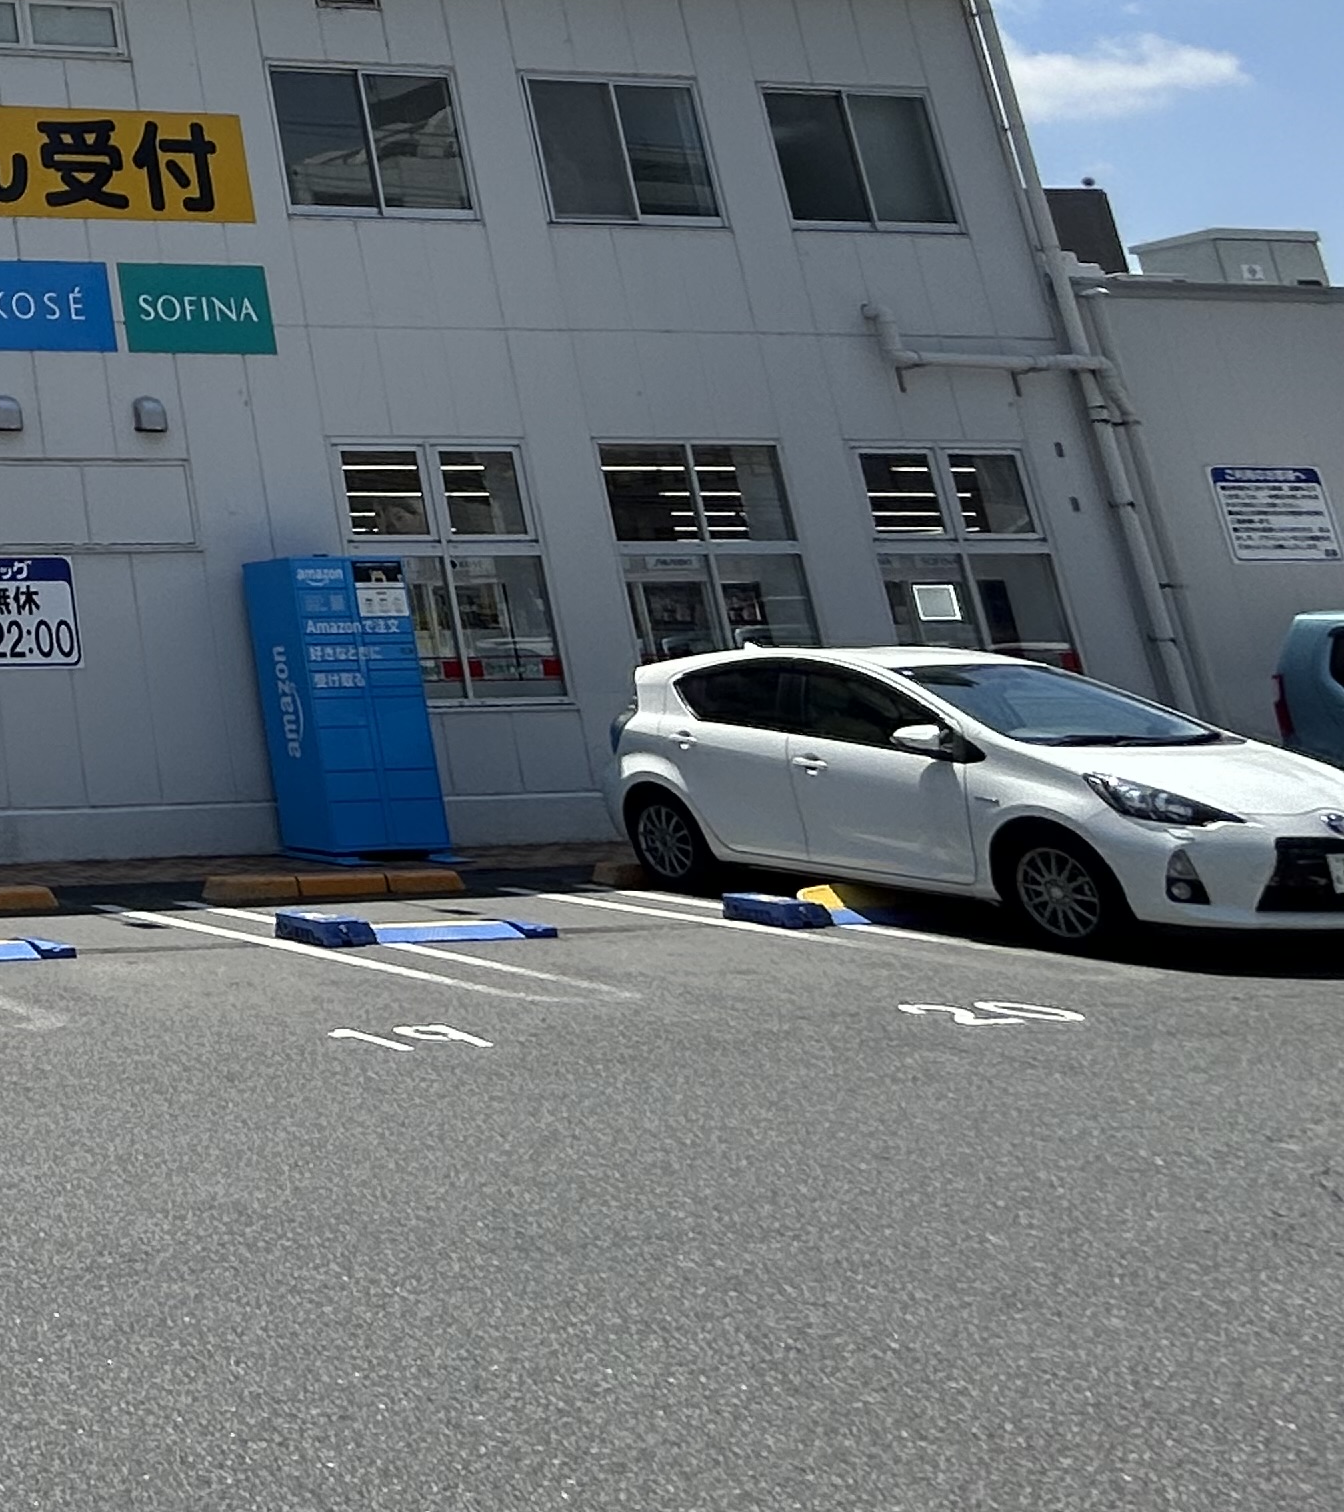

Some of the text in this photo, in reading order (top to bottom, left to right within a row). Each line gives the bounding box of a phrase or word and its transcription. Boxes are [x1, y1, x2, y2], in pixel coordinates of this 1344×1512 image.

[139, 294, 259, 323] SOFINA
[296, 568, 343, 581] amazon
[273, 646, 302, 758] amazon
[328, 1024, 494, 1051] 19
